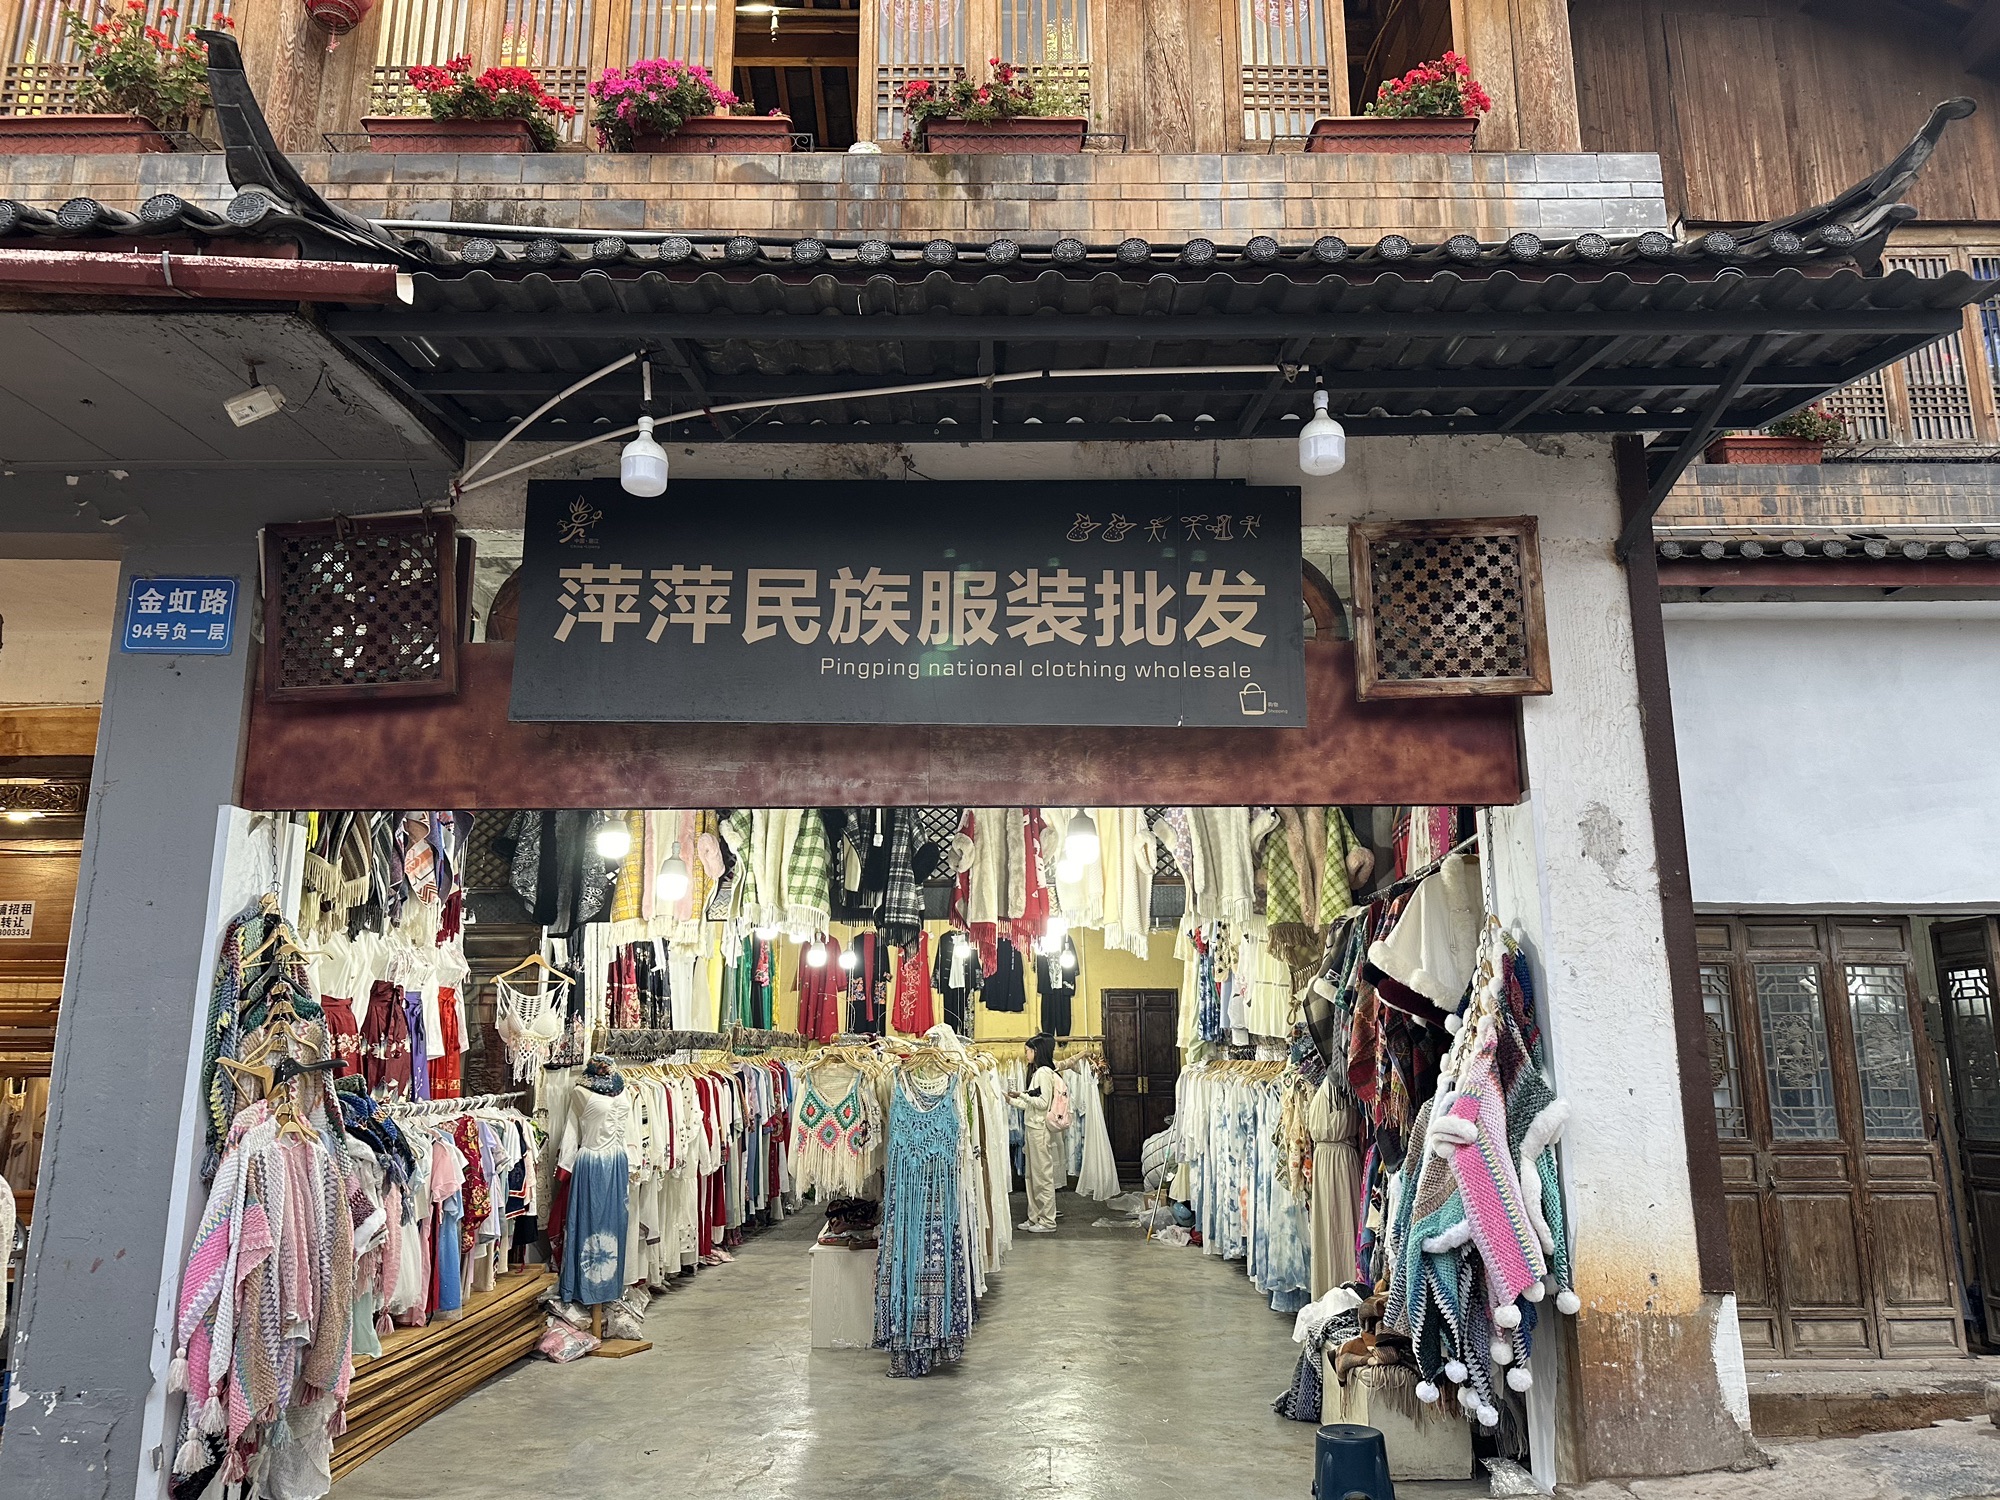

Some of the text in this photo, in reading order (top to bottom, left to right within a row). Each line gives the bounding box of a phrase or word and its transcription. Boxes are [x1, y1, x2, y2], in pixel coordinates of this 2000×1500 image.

[137, 587, 228, 615] 金虹路
[553, 563, 1267, 648] 萍萍民族服装批发
[131, 622, 225, 641] 94号负一层
[820, 657, 1251, 682] Pingping national clothing wholesale
[1, 916, 24, 928] 转让
